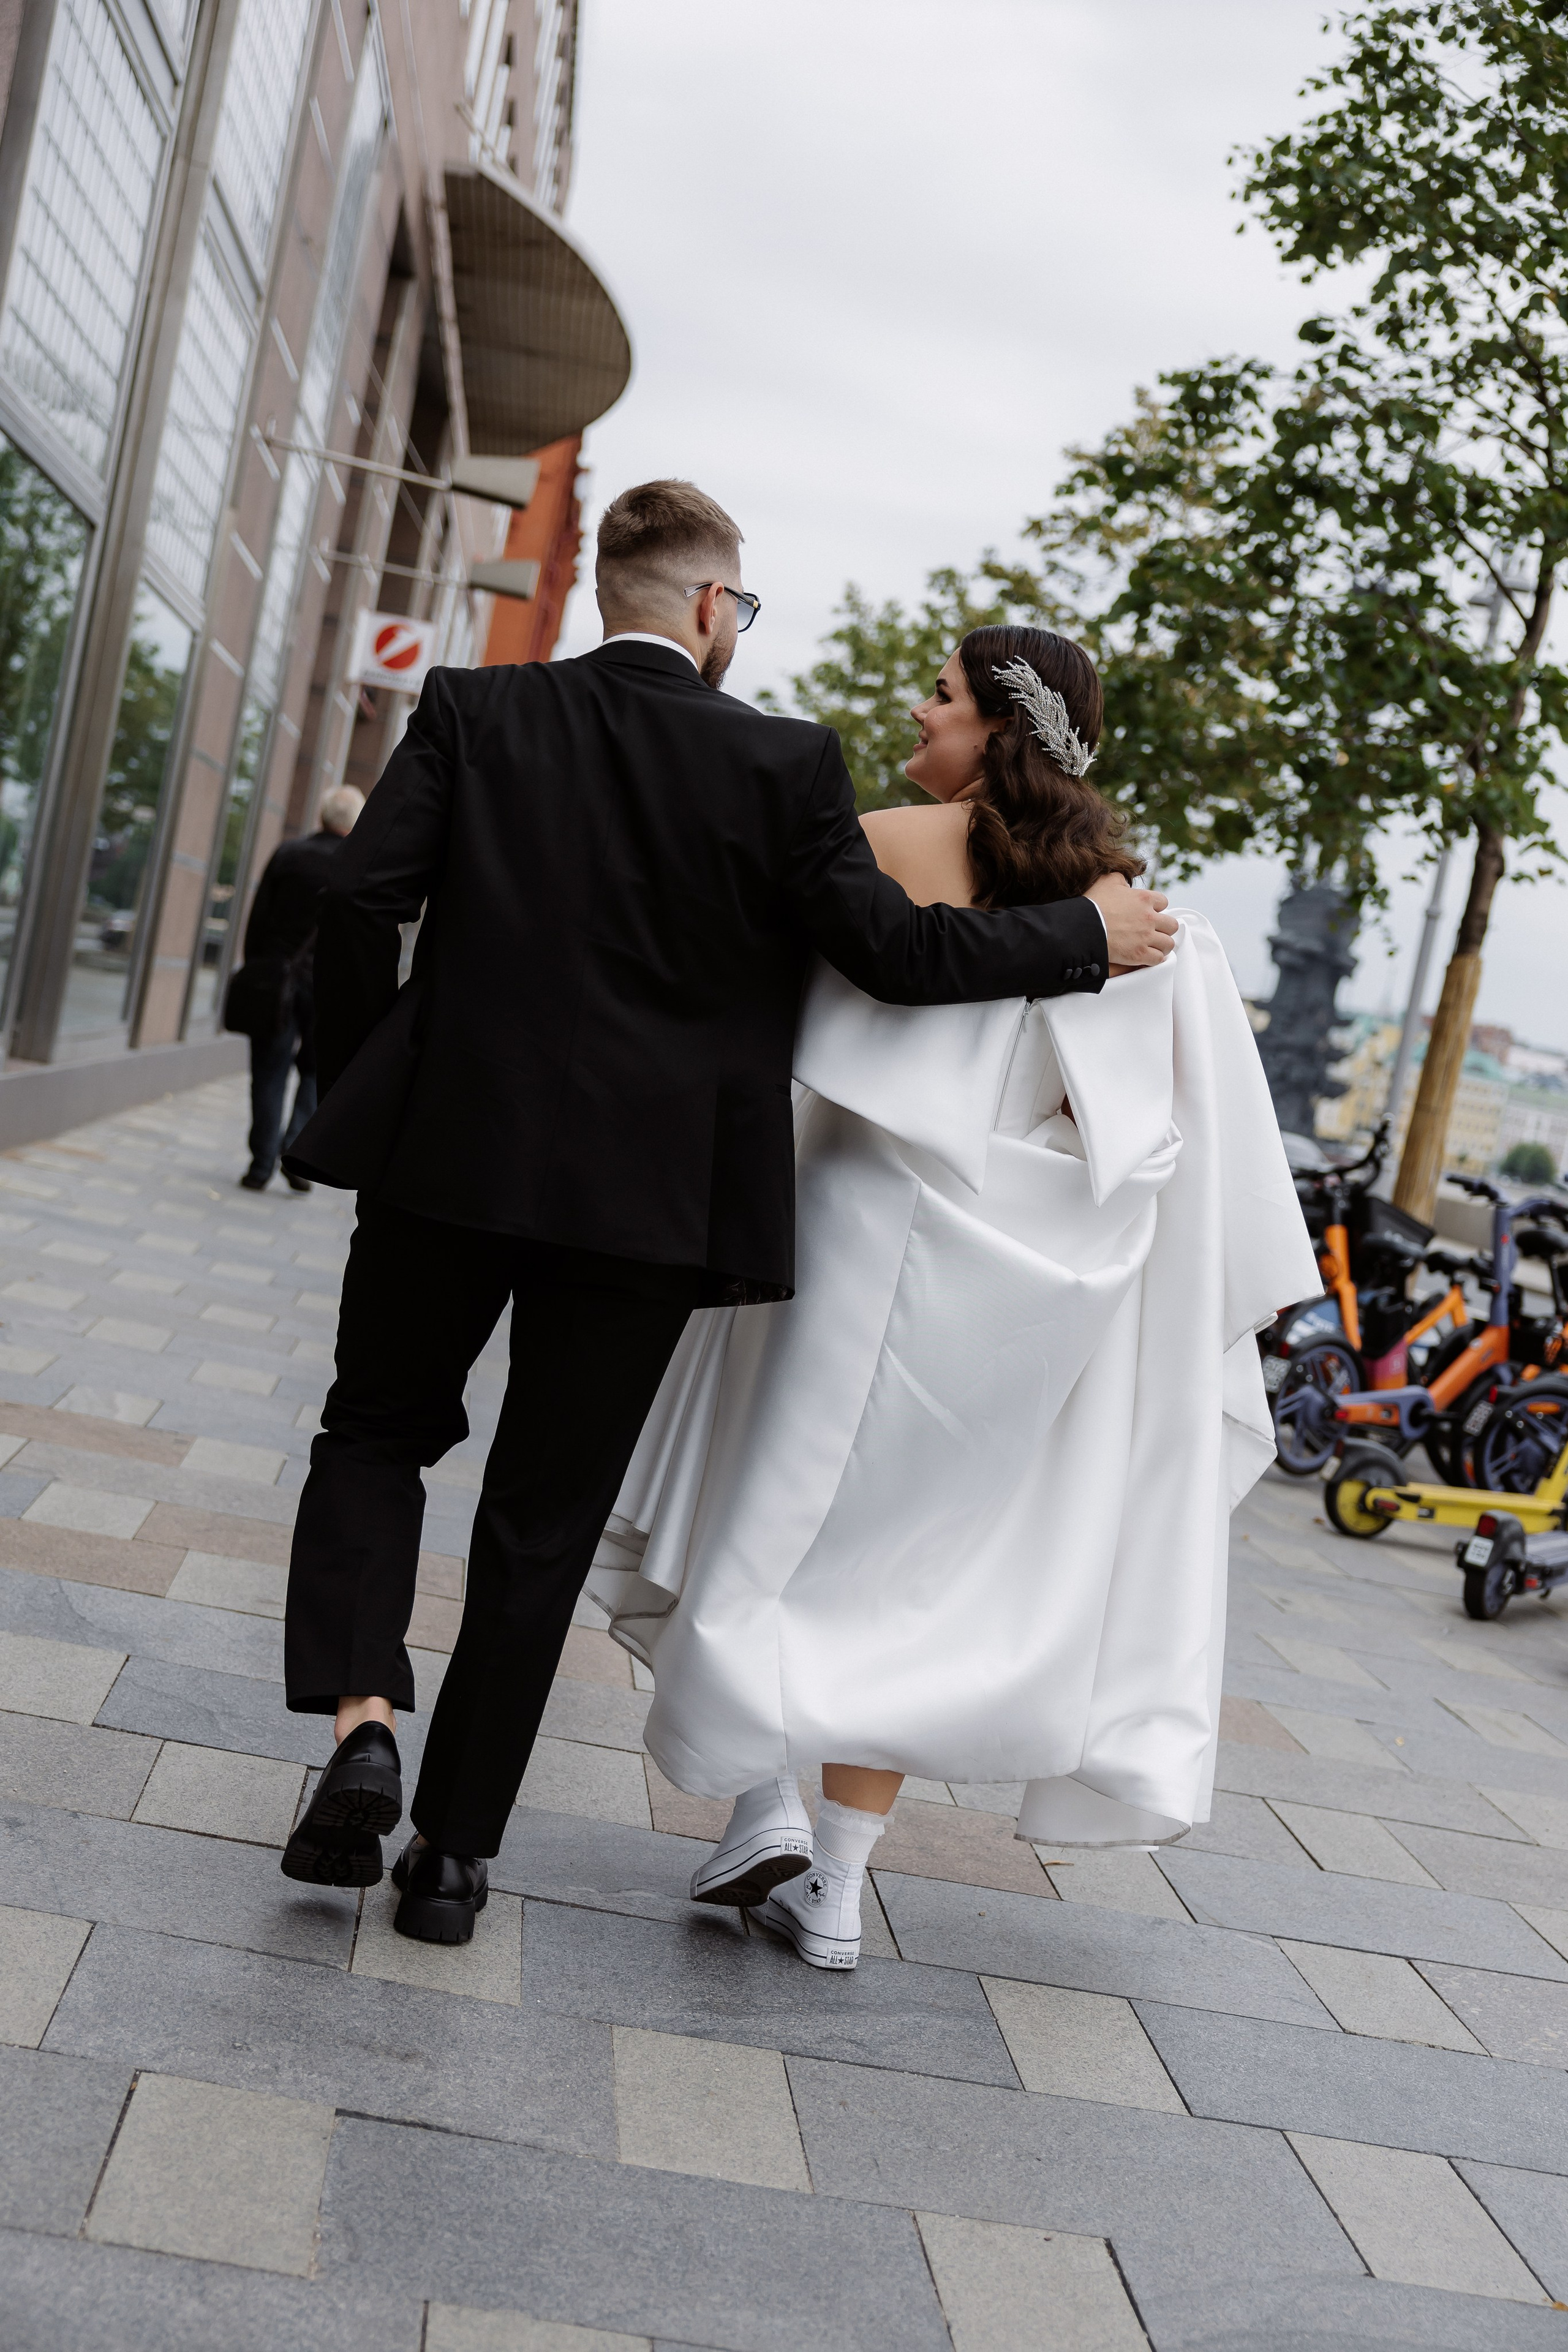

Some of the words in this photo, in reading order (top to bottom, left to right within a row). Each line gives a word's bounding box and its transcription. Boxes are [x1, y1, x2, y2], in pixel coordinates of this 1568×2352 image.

[784, 1842, 793, 1852] ALL
[799, 1844, 809, 1855] STAR
[807, 1872, 827, 1888] CONVERSE
[843, 1956, 854, 1965] STAR
